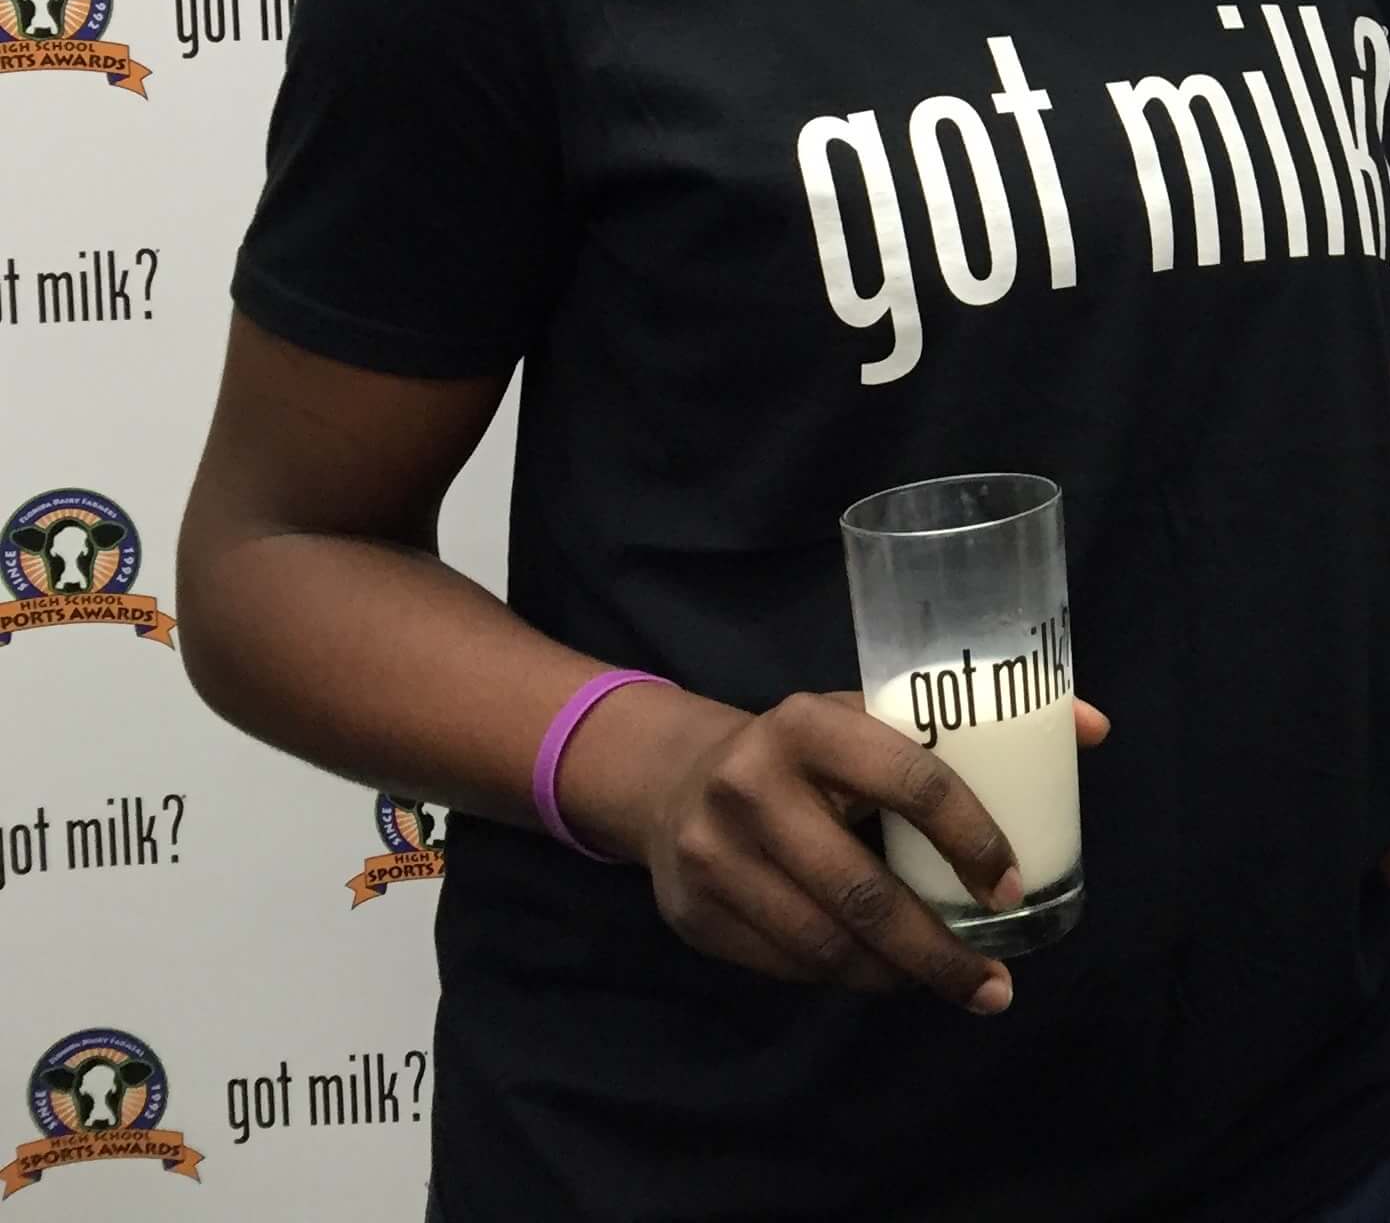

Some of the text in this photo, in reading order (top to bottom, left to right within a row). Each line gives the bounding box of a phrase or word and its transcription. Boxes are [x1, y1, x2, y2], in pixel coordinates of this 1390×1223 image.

[797, 35, 1077, 385] got
[37, 248, 158, 323] milk?
[0, 607, 155, 629] PORTS AWARDS
[21, 595, 123, 610] HIGH SCHOOL
[910, 649, 976, 749] got
[0, 794, 186, 888] ot milk?
[228, 1050, 428, 1144] got milk?
[21, 1144, 181, 1169] SPORTS AWARDS
